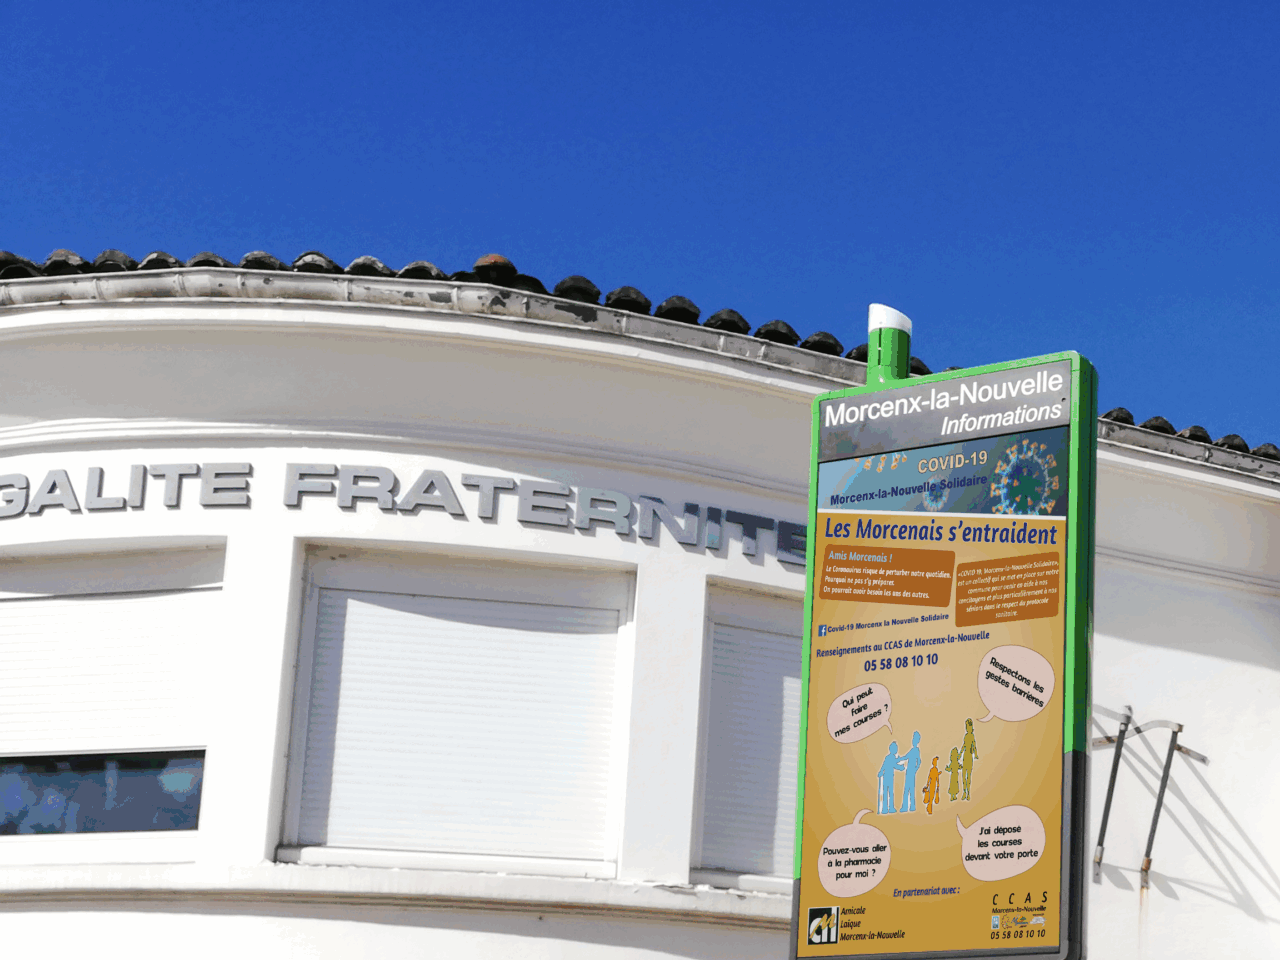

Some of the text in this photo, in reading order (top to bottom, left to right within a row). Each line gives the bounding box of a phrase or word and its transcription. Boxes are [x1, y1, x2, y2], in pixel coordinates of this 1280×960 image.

[825, 371, 1063, 427] Morcenx-la-Nouvelle
[941, 403, 1062, 435] Informations
[918, 450, 988, 473] COVID-19
[830, 476, 988, 505] Morcenx-la-Nouvelle Solidaire
[283, 462, 808, 566] FRATERNITE
[825, 518, 851, 538] Les
[856, 519, 943, 541] Morcenais
[828, 550, 892, 562] Amis Morcenais !
[833, 566, 861, 574] Coronavirus
[926, 571, 951, 579] quotidien.
[984, 564, 1033, 573] Morcenx-la-Nouvelle
[825, 576, 846, 584] Pourquoi
[973, 576, 991, 584] collectif
[958, 596, 986, 604] concitoyens
[1004, 589, 1043, 598] particulièrement
[1002, 601, 1018, 609] respect
[1026, 598, 1049, 607] protocole
[995, 610, 1018, 618] sanitaire.
[828, 623, 854, 633] Covid-19
[856, 621, 882, 629] Morcenx
[892, 617, 919, 626] Nouvelle
[921, 613, 949, 622] Solidaire
[816, 631, 990, 658] Renseignements au CCAS de Morcenx-la-Nouvelle
[864, 653, 938, 672] 05 58 08 10 10
[985, 670, 1009, 688] gestes
[990, 657, 1045, 693] Respectons les
[842, 687, 873, 708] Qui peut
[851, 703, 868, 717] faire
[835, 704, 888, 738] mes courses ?
[823, 844, 887, 855] Pouvez-vous aller
[978, 839, 1022, 848] les courses
[965, 849, 1038, 861] devant votre porte
[835, 859, 841, 867] la
[844, 857, 881, 868] pharmacie
[836, 872, 852, 881] pour
[855, 869, 868, 878] moi
[893, 889, 902, 897] En
[903, 886, 940, 899] partenariat
[841, 906, 866, 915] Amicale
[992, 905, 1046, 913] Morcenx-la-Nouvelle
[840, 930, 905, 941] Morcenx-la-Nouvelle
[991, 929, 1045, 939] 05 58 08 10 10
